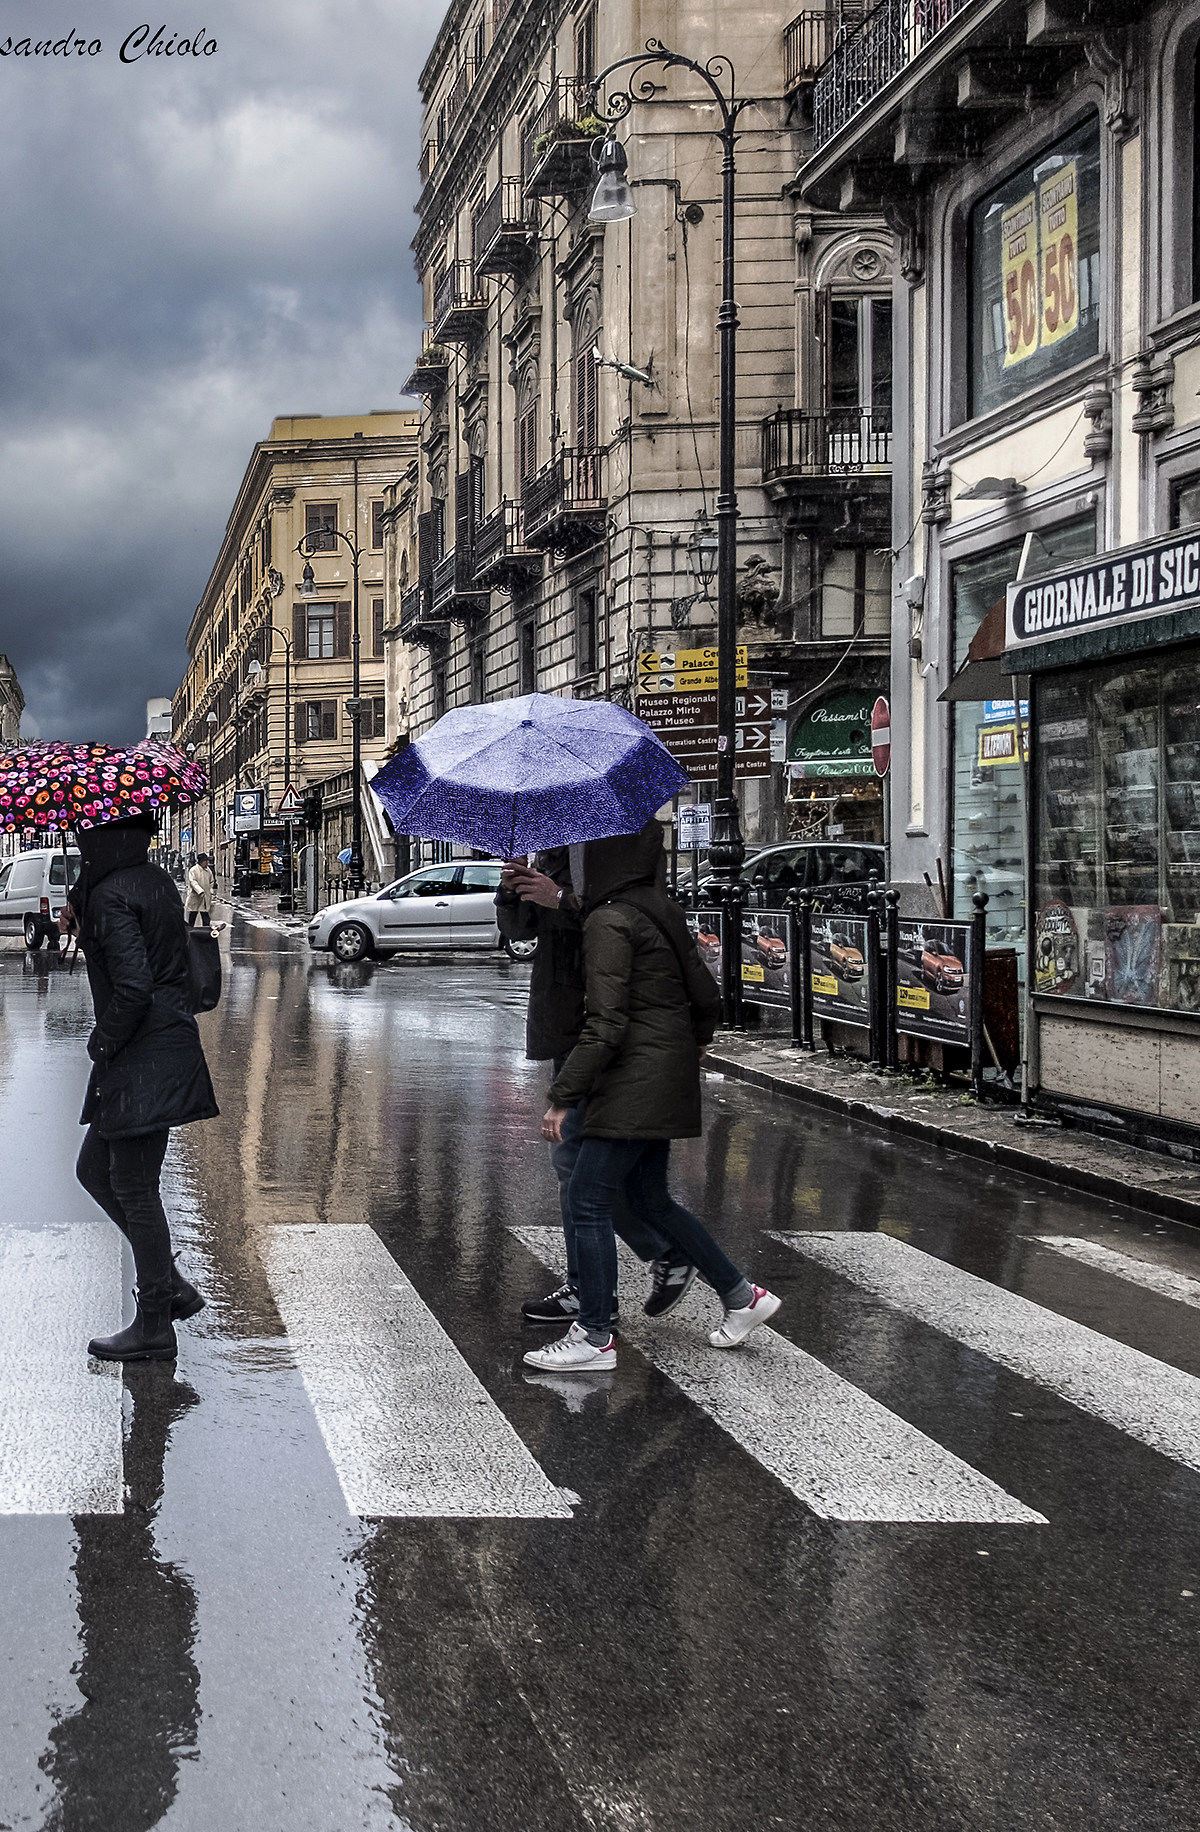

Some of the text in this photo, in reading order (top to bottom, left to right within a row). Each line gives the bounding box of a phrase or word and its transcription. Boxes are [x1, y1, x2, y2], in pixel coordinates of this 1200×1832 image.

[1045, 233, 1075, 333] 50
[1006, 260, 1036, 354] 50
[1024, 542, 1200, 633] GIORNALE DI SIC
[682, 660, 714, 668] Palace
[640, 695, 716, 707] Museo Regionale
[640, 707, 701, 717] Palazzo Mirto
[665, 717, 695, 725] Museo
